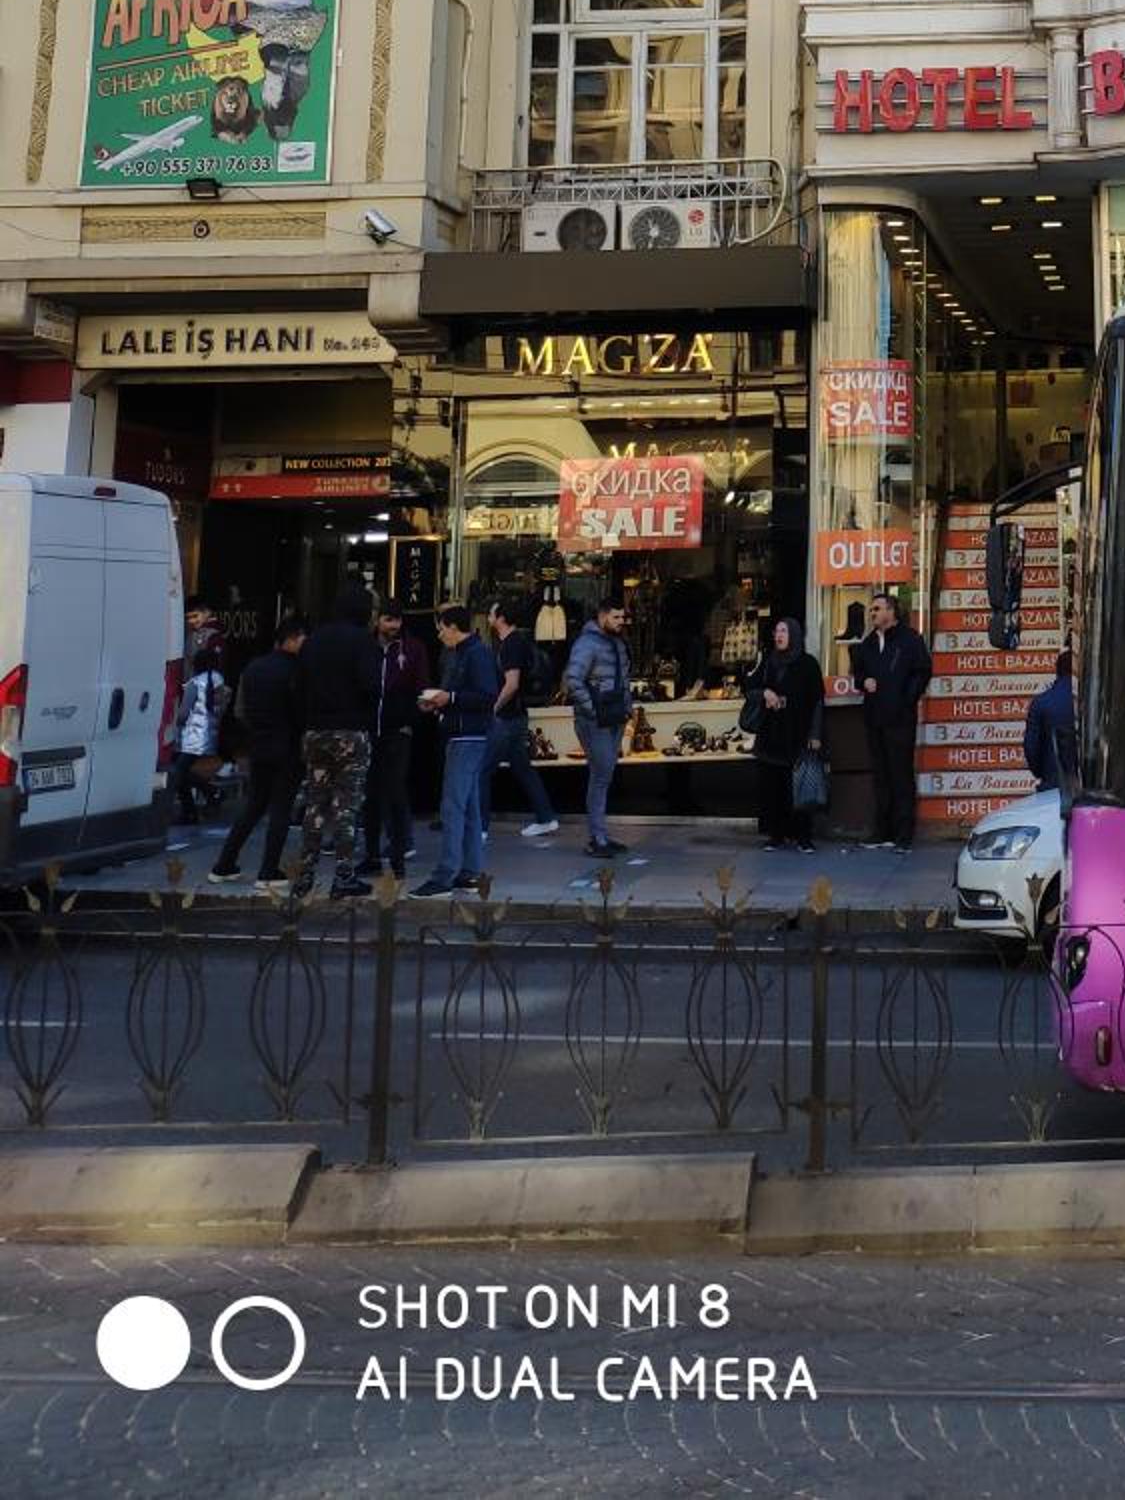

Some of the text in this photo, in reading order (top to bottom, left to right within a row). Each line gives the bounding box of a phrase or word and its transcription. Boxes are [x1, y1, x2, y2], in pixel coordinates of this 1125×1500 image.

[97, 50, 251, 98] CHEAP AIRLINE
[139, 87, 210, 118] TICKET
[833, 67, 1034, 133] HOTEL
[121, 158, 156, 175] +90
[161, 156, 191, 173] 555
[225, 155, 246, 172] 76
[250, 155, 272, 171] 33
[101, 327, 177, 357] LALE
[184, 320, 215, 359] İŞ
[225, 326, 315, 354] HANI
[514, 333, 714, 376] MAGZA
[831, 401, 908, 428] SALE
[286, 458, 309, 469] NEW
[578, 506, 688, 538] SALE
[829, 541, 909, 570] OUTLET
[957, 654, 1000, 672] HOTEL
[953, 701, 998, 716] HOTEL
[949, 750, 997, 767] HOTEL
[946, 800, 994, 816] HOTEL
